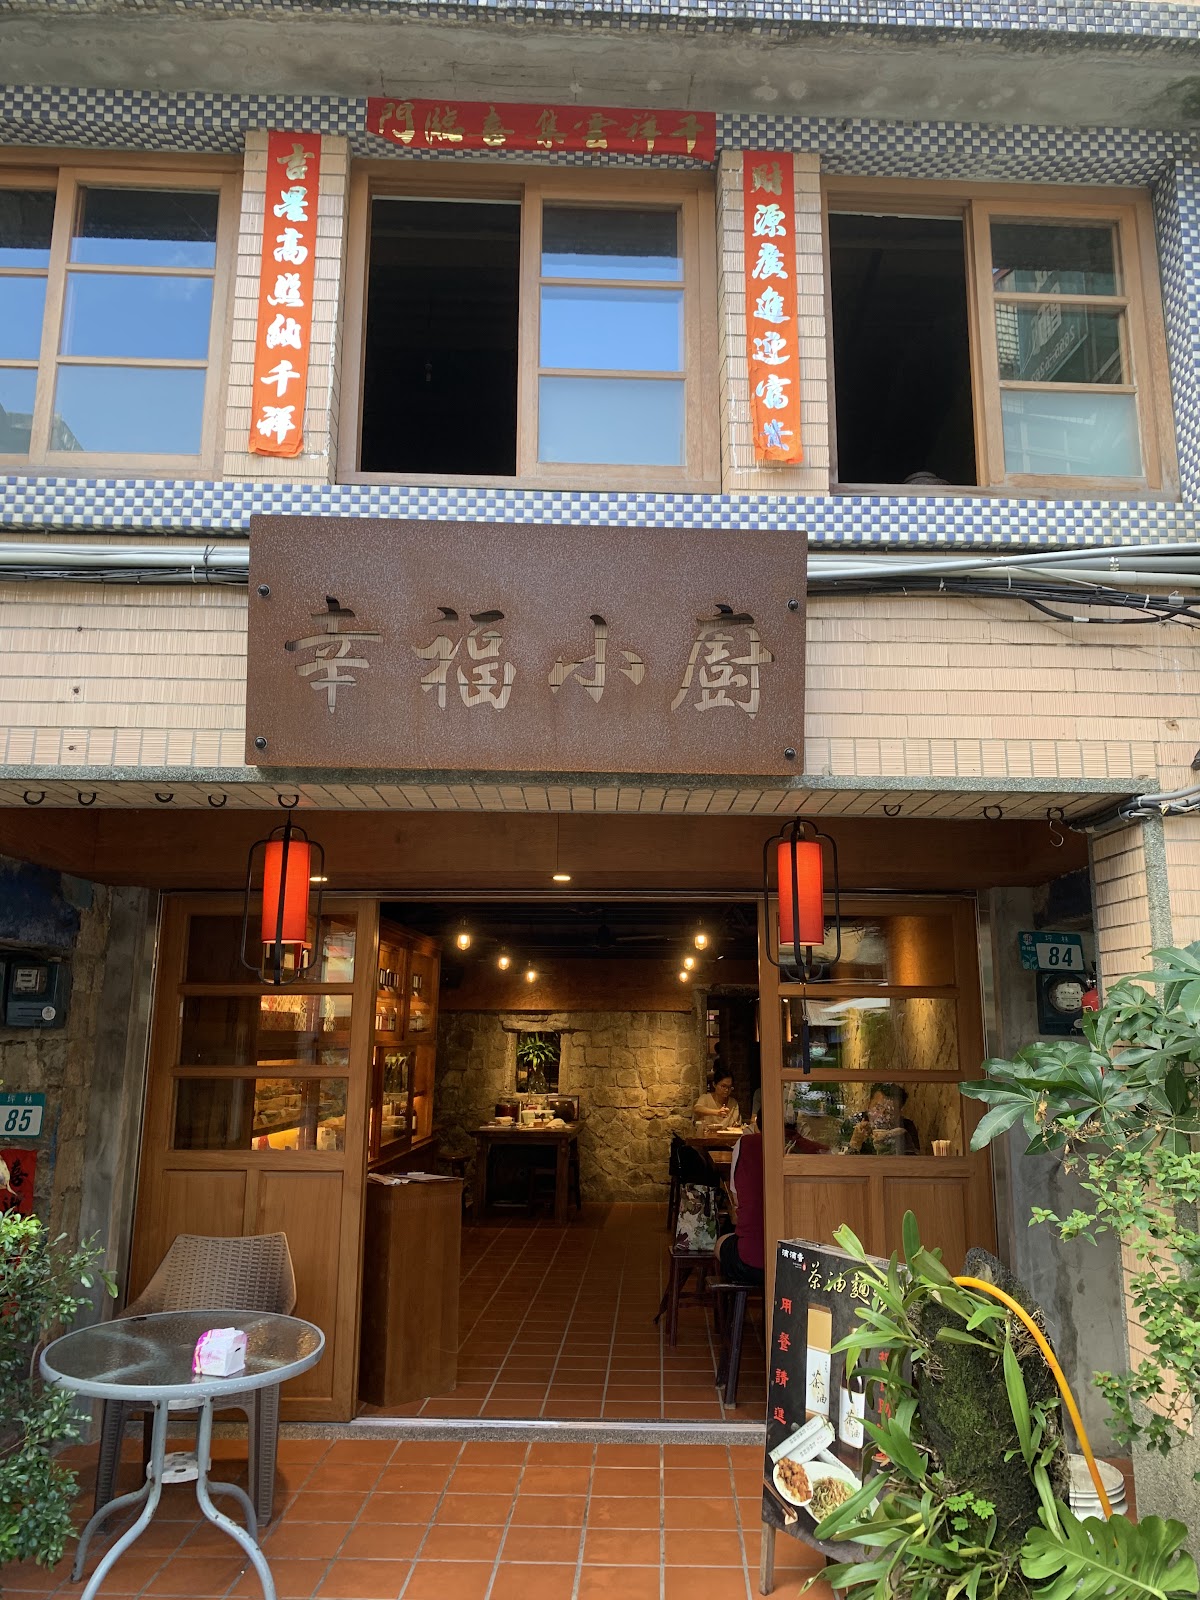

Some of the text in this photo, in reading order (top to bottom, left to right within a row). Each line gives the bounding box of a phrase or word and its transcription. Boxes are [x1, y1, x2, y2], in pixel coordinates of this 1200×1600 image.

[256, 143, 316, 445] 吉星高照納千祥
[284, 595, 774, 721] 幸福小廚
[1048, 946, 1073, 967] 84
[4, 1109, 33, 1132] 85
[773, 1297, 793, 1425] 用餐請進
